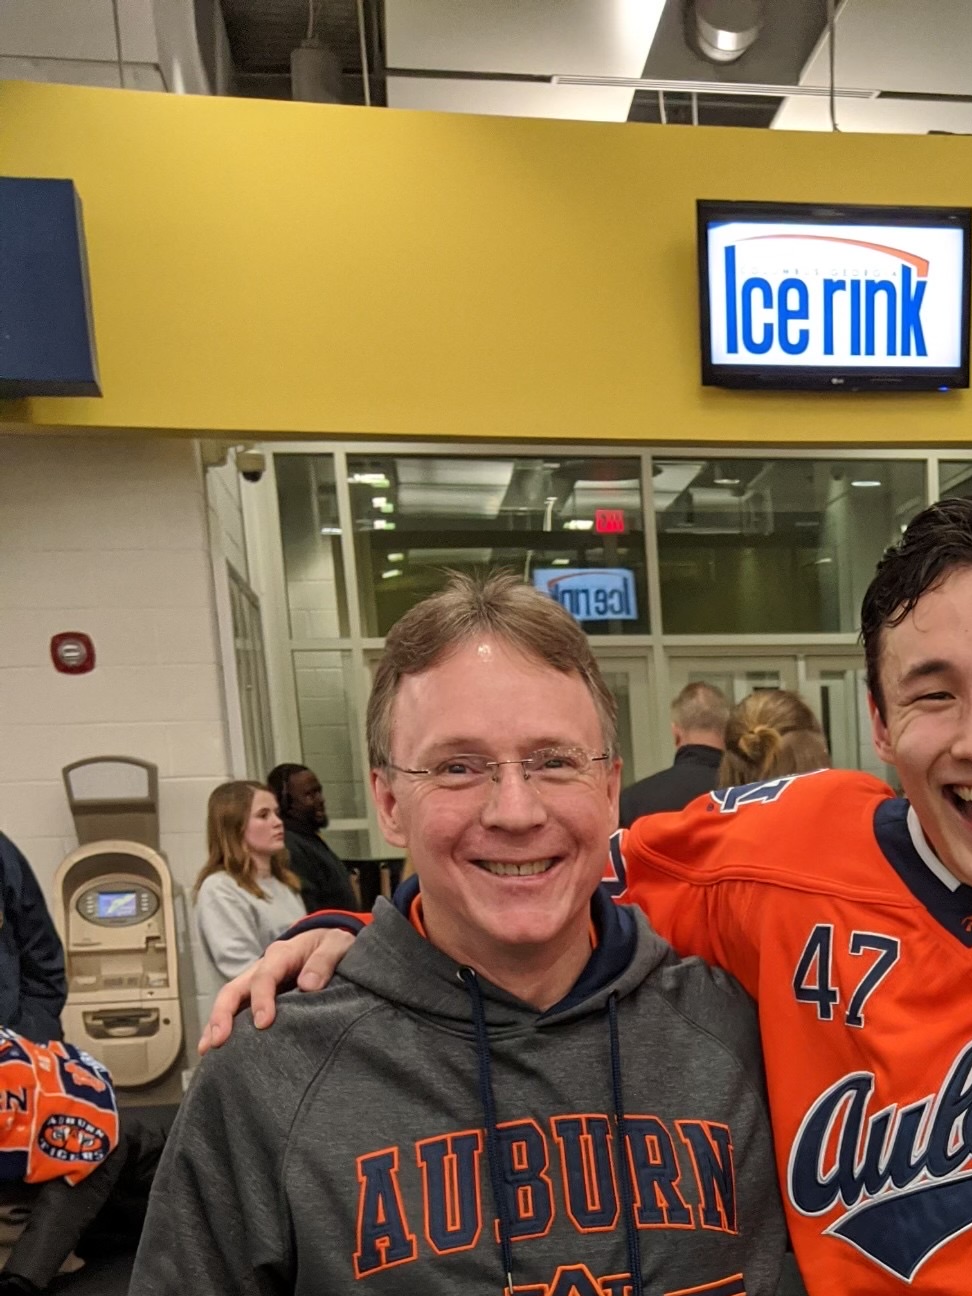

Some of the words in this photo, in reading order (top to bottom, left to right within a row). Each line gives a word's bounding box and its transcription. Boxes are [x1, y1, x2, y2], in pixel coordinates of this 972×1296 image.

[725, 245, 810, 355] Ice
[823, 264, 928, 357] rink
[791, 923, 901, 1029] 47
[353, 1113, 740, 1280] AUBURN
